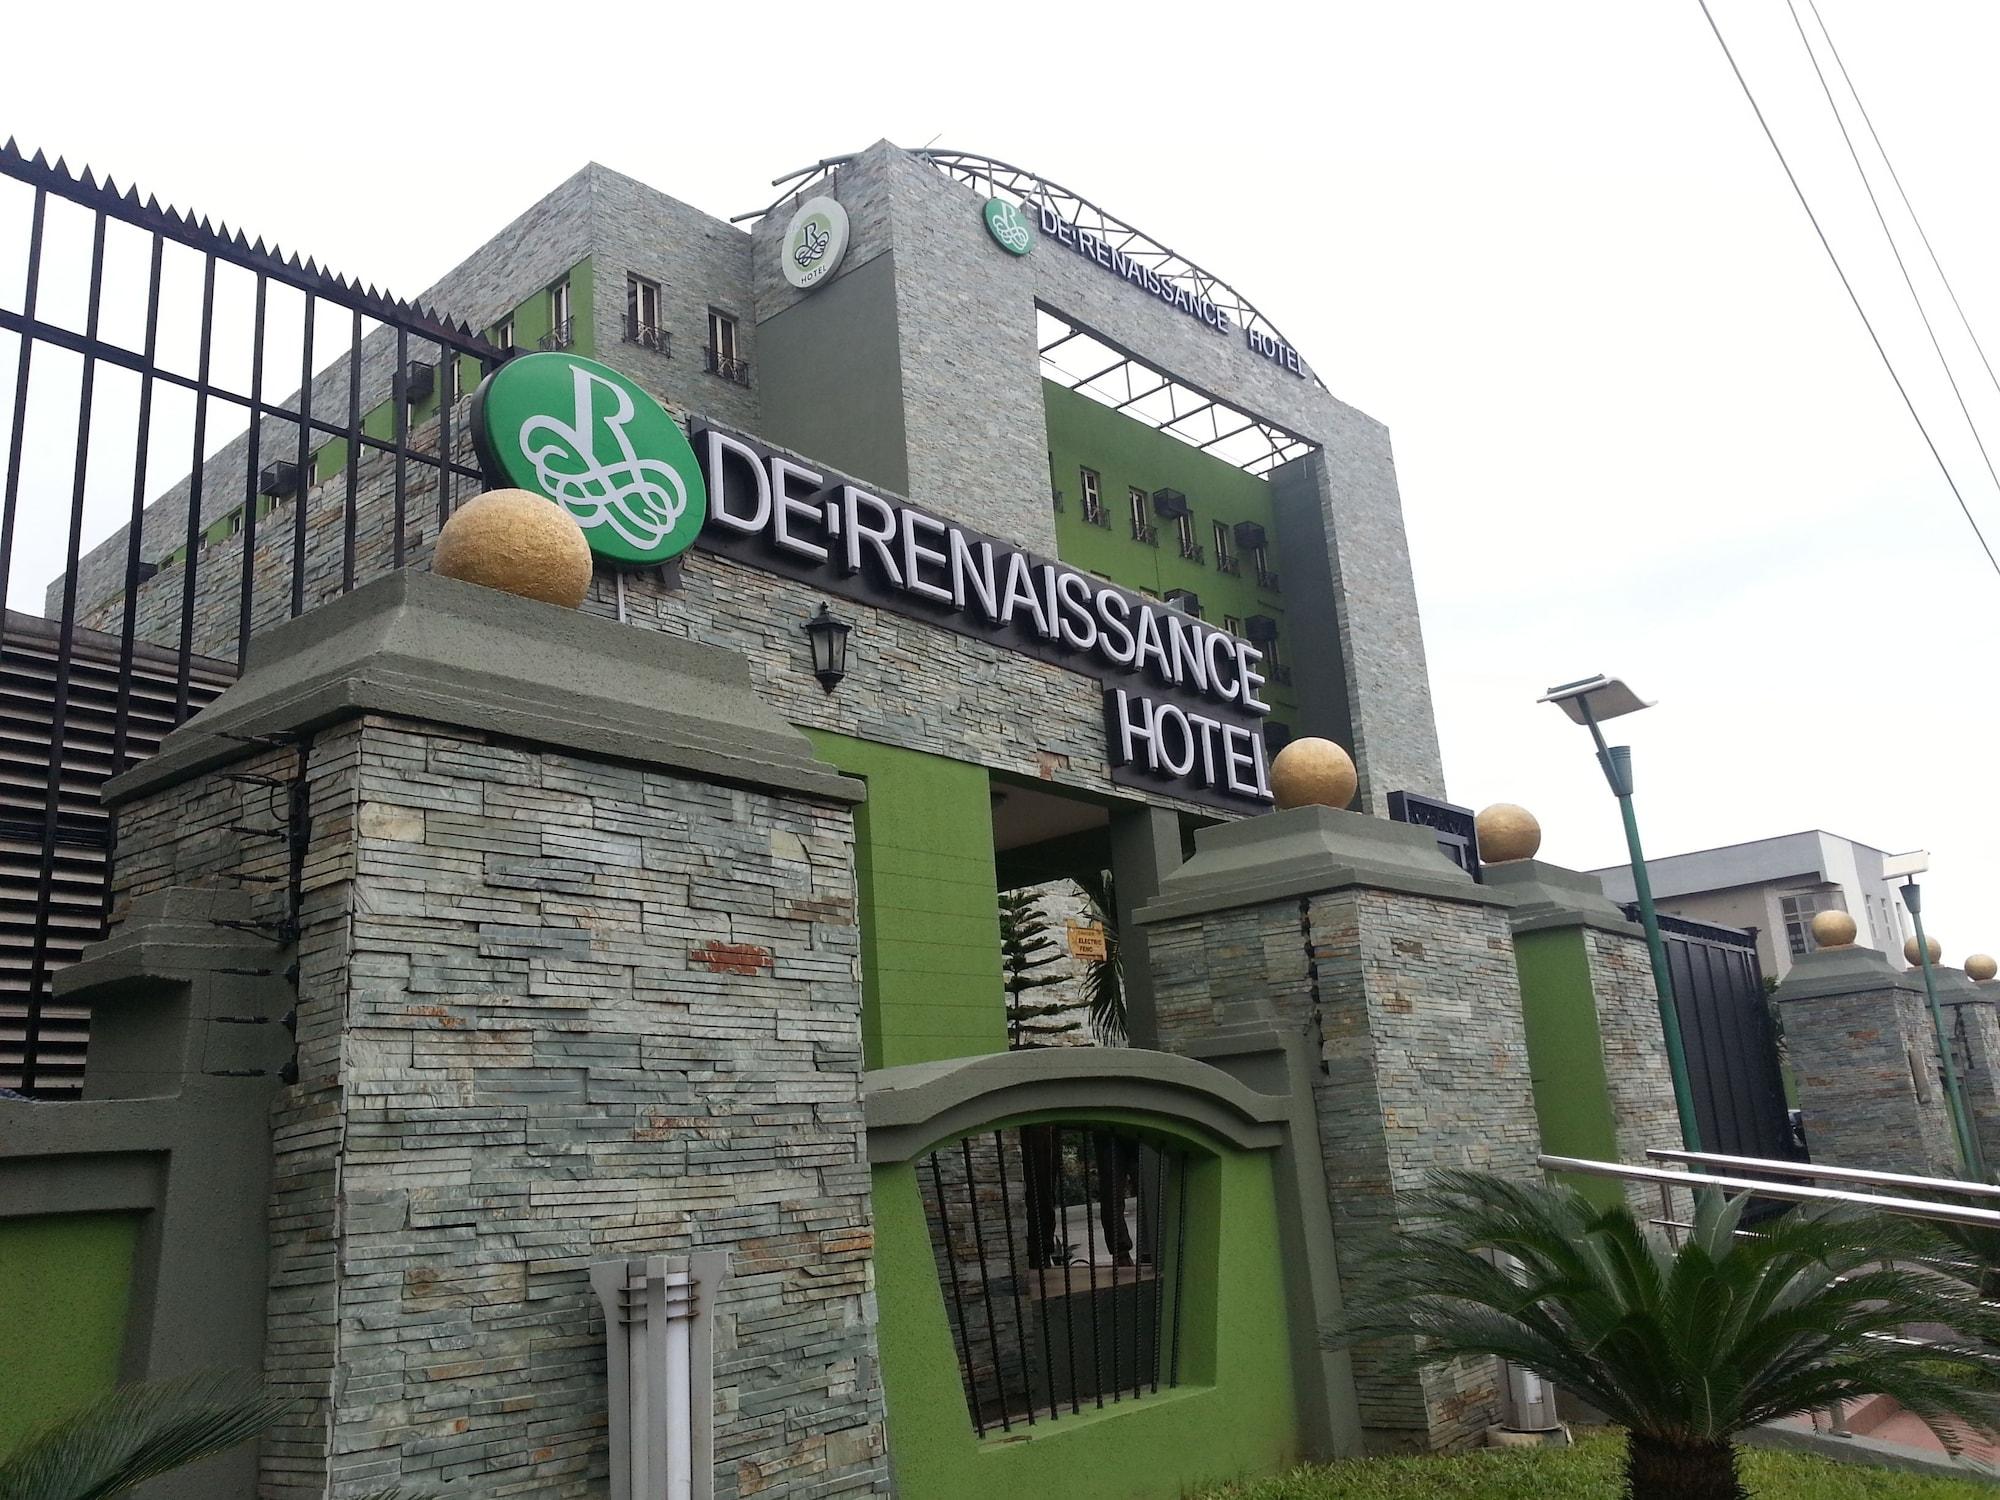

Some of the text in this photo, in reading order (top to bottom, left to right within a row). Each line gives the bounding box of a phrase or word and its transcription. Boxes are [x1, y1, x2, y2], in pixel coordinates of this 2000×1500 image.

[801, 265, 826, 284] HOTEL
[1249, 330, 1306, 379] HOTEL
[1116, 689, 1274, 799] HOTEL
